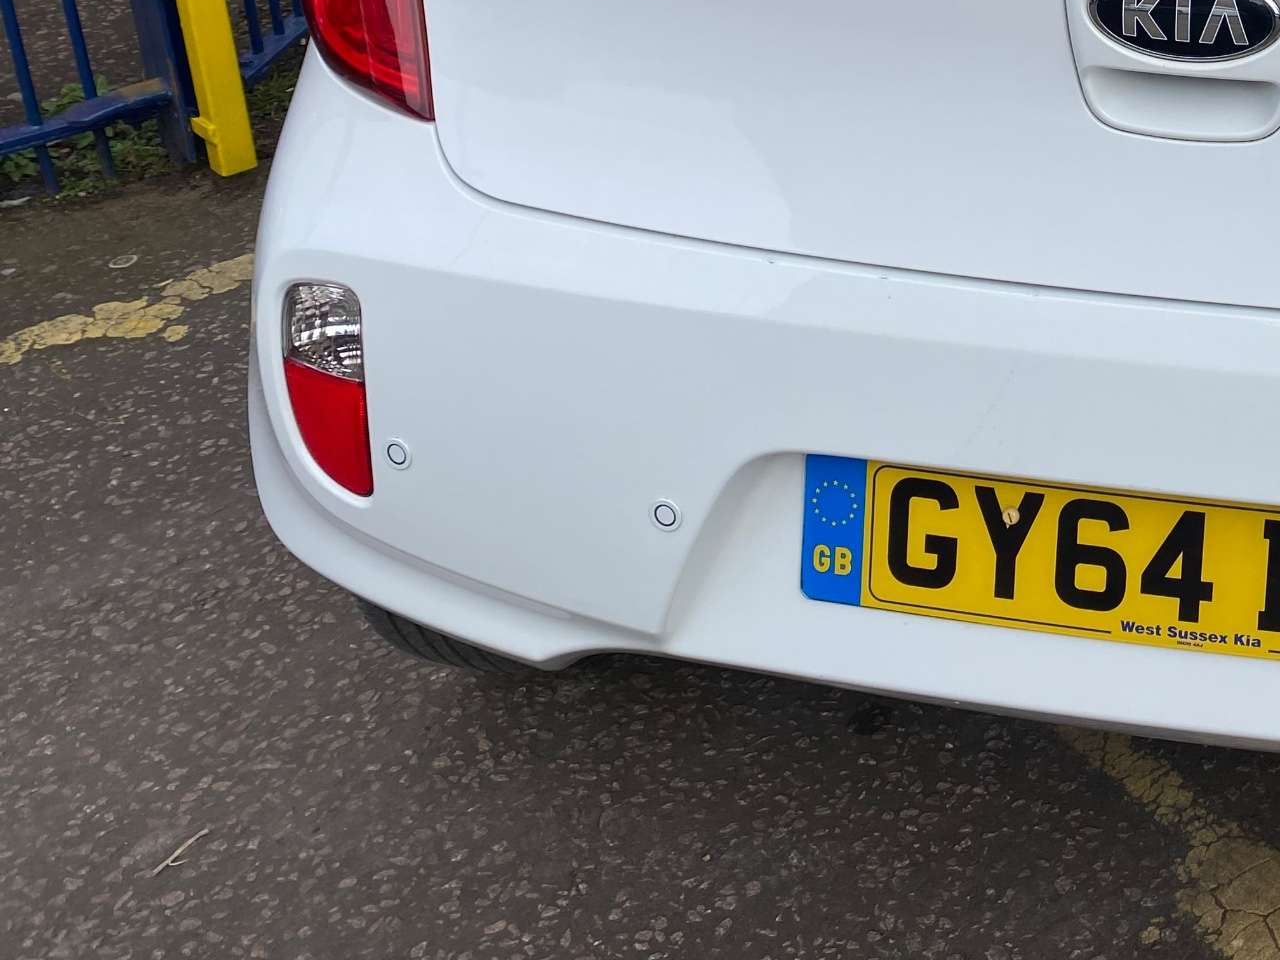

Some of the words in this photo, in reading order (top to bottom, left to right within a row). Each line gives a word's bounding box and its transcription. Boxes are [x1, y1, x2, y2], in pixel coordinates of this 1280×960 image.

[812, 543, 853, 577] GB
[887, 477, 1213, 623] GY64
[1120, 619, 1162, 637] West
[1167, 625, 1228, 645] Sussex
[1233, 633, 1261, 648] Kia
